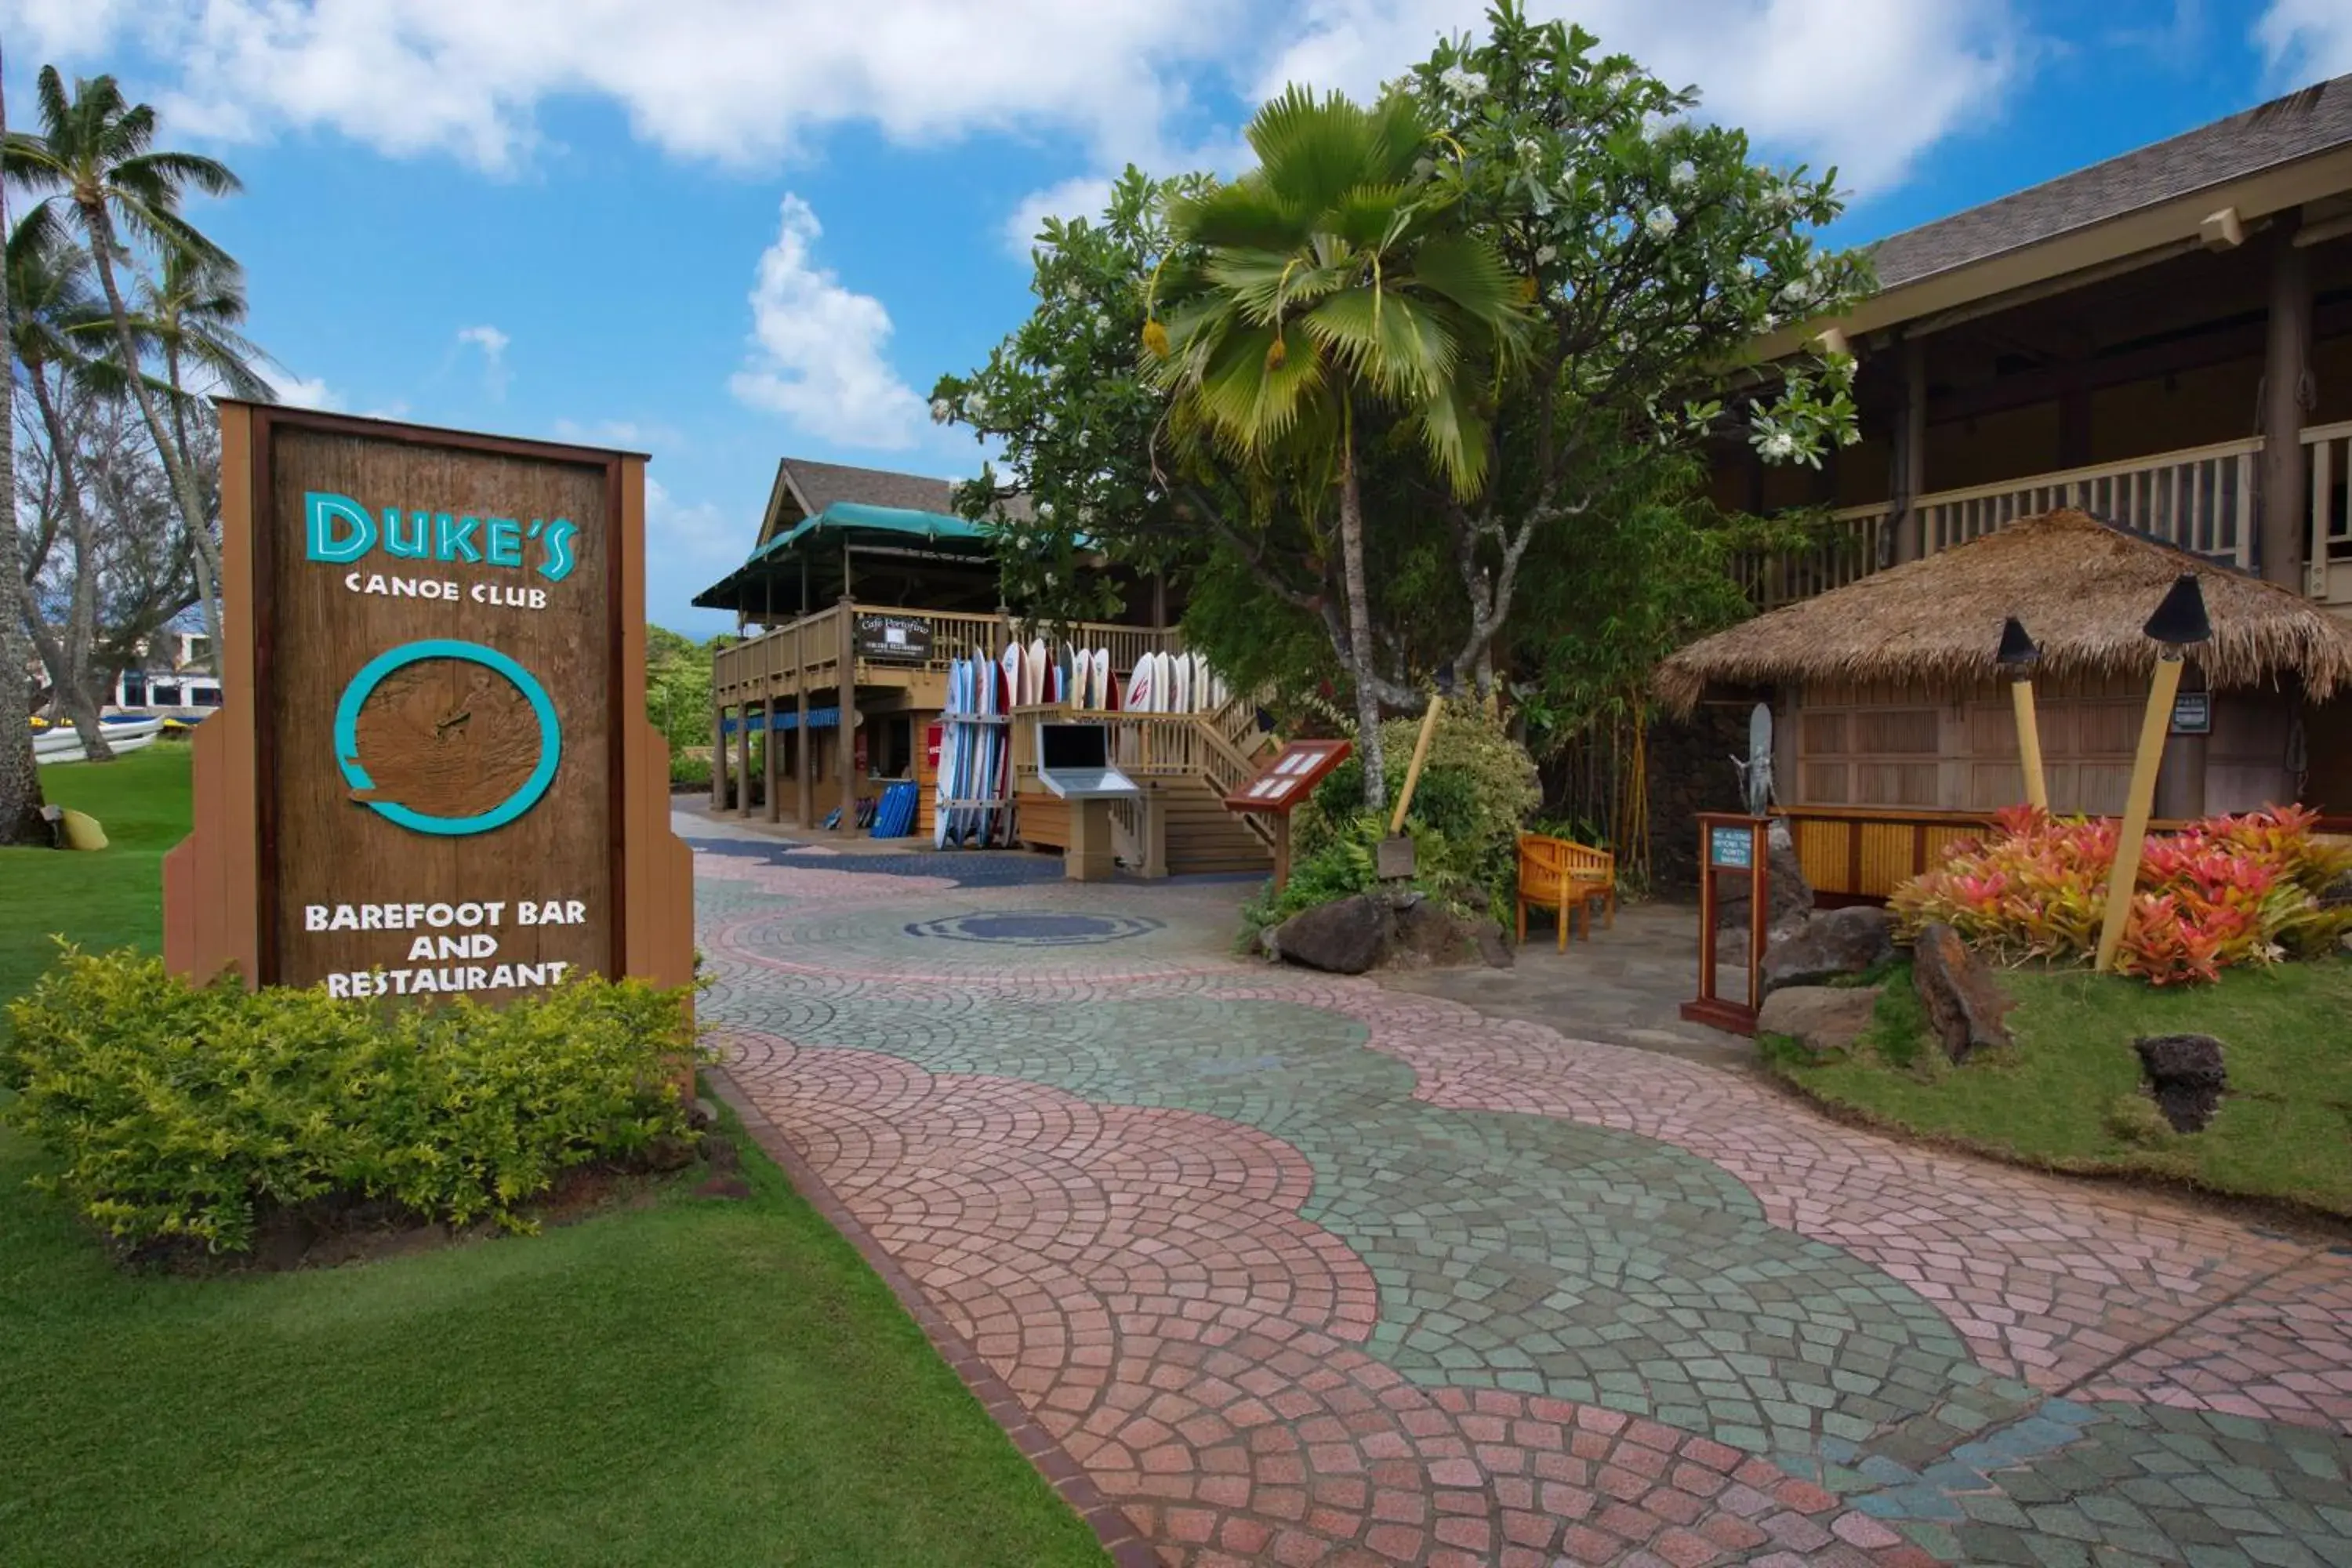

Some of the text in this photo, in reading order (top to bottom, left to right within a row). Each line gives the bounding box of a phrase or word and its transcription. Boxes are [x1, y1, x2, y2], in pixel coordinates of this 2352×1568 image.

[304, 492, 579, 582] DUKE'S
[344, 572, 547, 609] CANOE CLUB
[305, 899, 586, 931] BAREFOOT BAR
[407, 934, 499, 961] AND
[327, 961, 568, 999] RESTAURANT
